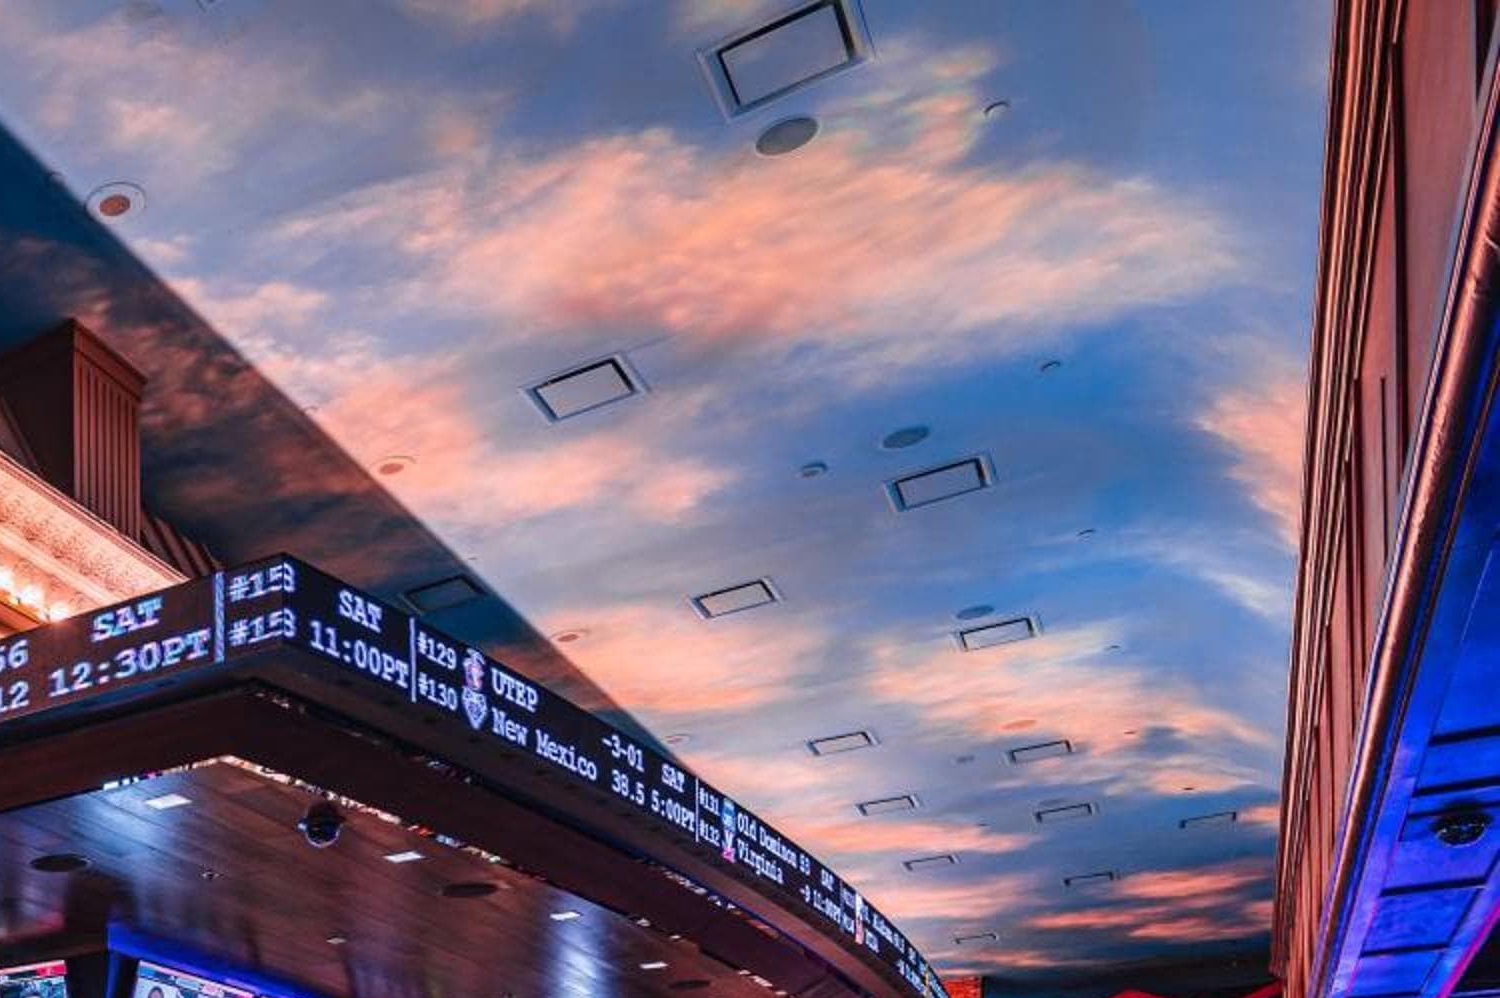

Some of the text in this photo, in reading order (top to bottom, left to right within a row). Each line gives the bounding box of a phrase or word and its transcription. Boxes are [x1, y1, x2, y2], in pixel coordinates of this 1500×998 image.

[91, 596, 163, 642] SAT
[338, 591, 384, 634] SAT
[48, 629, 211, 698] 12:30PT
[308, 619, 410, 690] 11:00PT
[417, 631, 457, 670] #129
[491, 667, 538, 714] UTEP
[661, 763, 686, 794] SAT
[417, 672, 696, 834] #130 New Mexico 38.5 5:00PT
[737, 813, 757, 842] Old
[737, 838, 783, 885] Virginia
